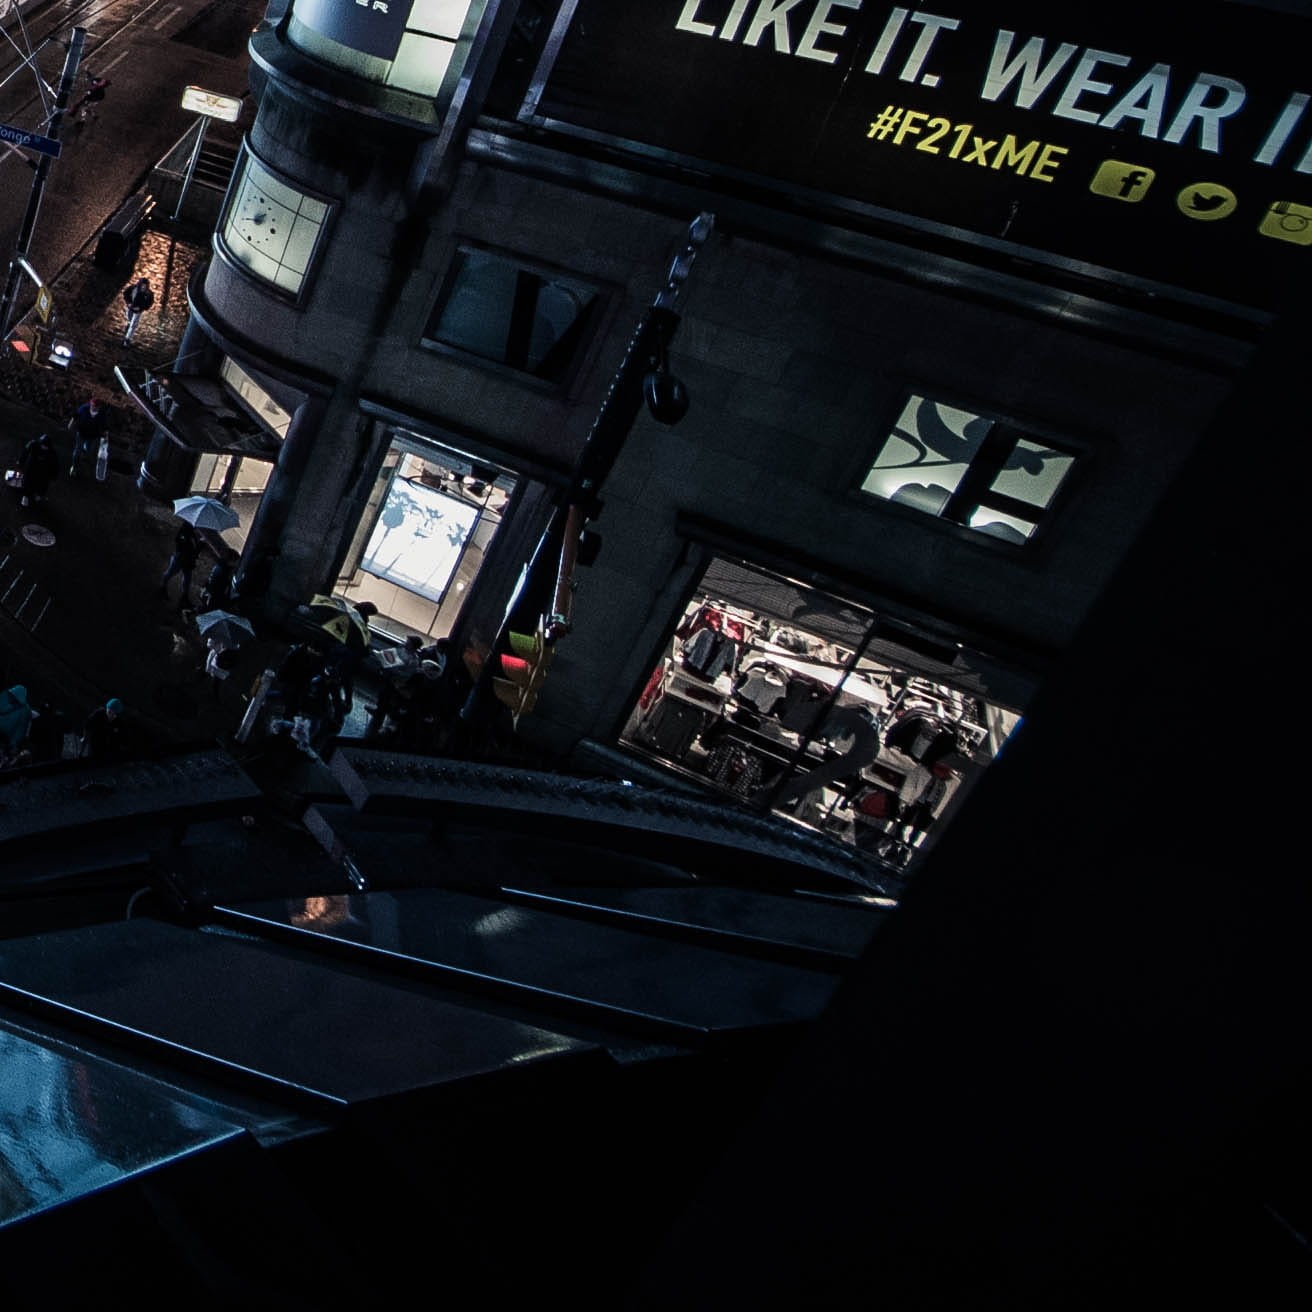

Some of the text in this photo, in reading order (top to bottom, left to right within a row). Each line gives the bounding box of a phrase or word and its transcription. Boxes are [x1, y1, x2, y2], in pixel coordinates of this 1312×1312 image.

[863, 6, 960, 88] IT.
[978, 28, 1248, 155] WEAR
[868, 104, 1072, 185] #F21xME
